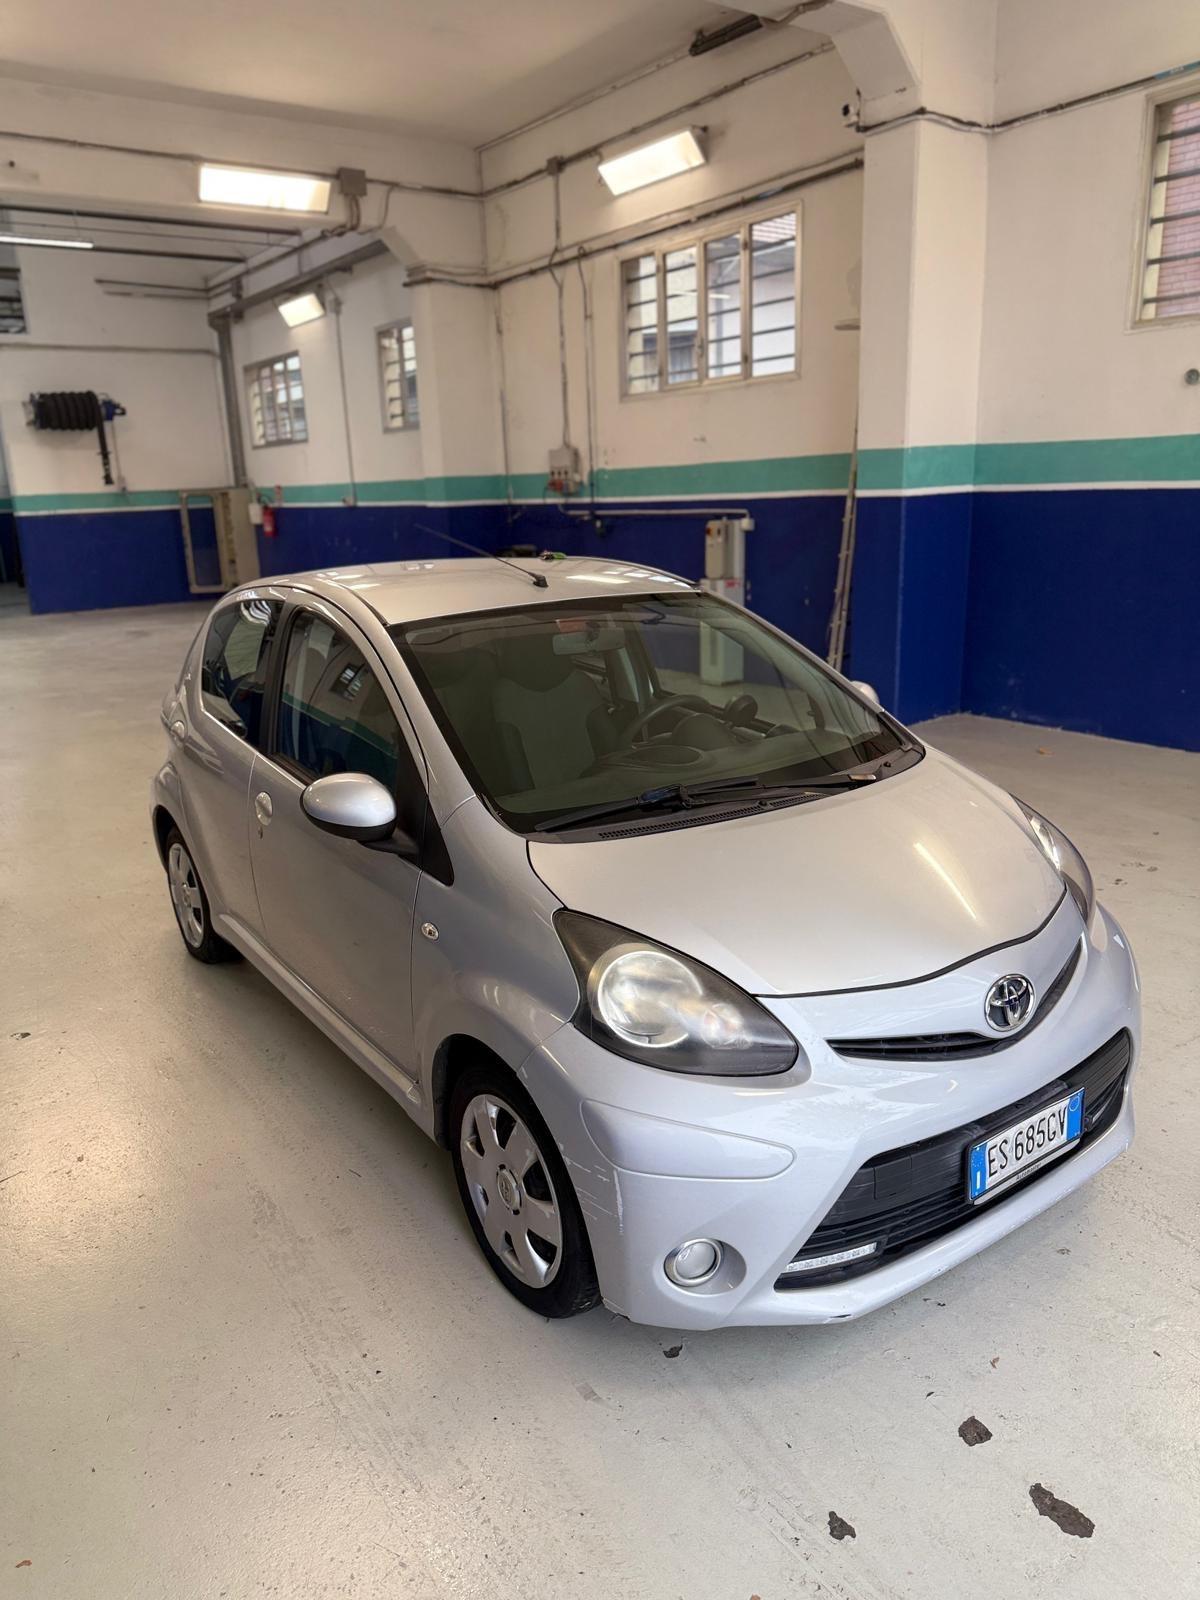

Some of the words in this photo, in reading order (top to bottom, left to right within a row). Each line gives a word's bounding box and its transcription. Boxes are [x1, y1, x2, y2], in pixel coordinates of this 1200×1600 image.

[988, 1138, 1008, 1178] ES
[1015, 1106, 1067, 1161] 685GV
[976, 1171, 981, 1190] I
